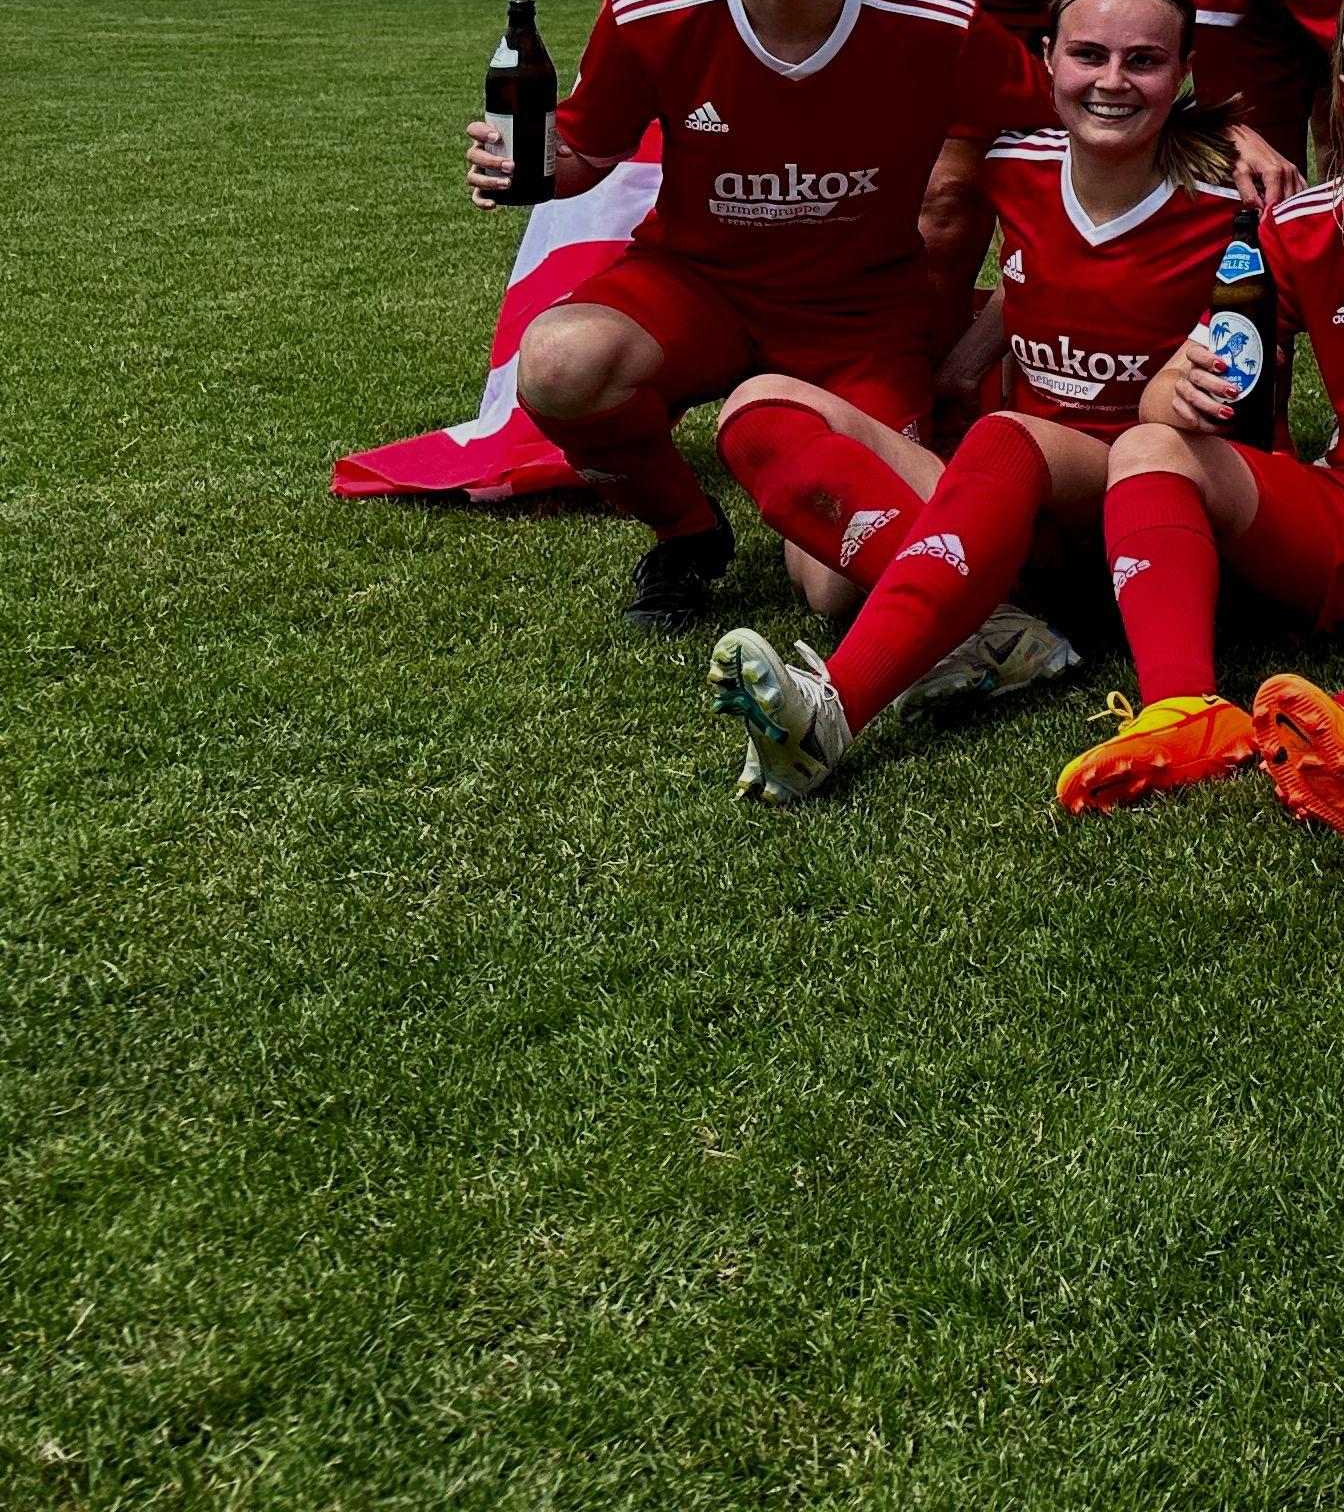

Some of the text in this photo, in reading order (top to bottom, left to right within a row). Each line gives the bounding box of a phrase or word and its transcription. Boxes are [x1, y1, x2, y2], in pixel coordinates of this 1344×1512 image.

[684, 119, 730, 133] adidas
[714, 163, 880, 201] ankox
[716, 202, 821, 218] Firmengruppe
[1011, 334, 1150, 382] ankox
